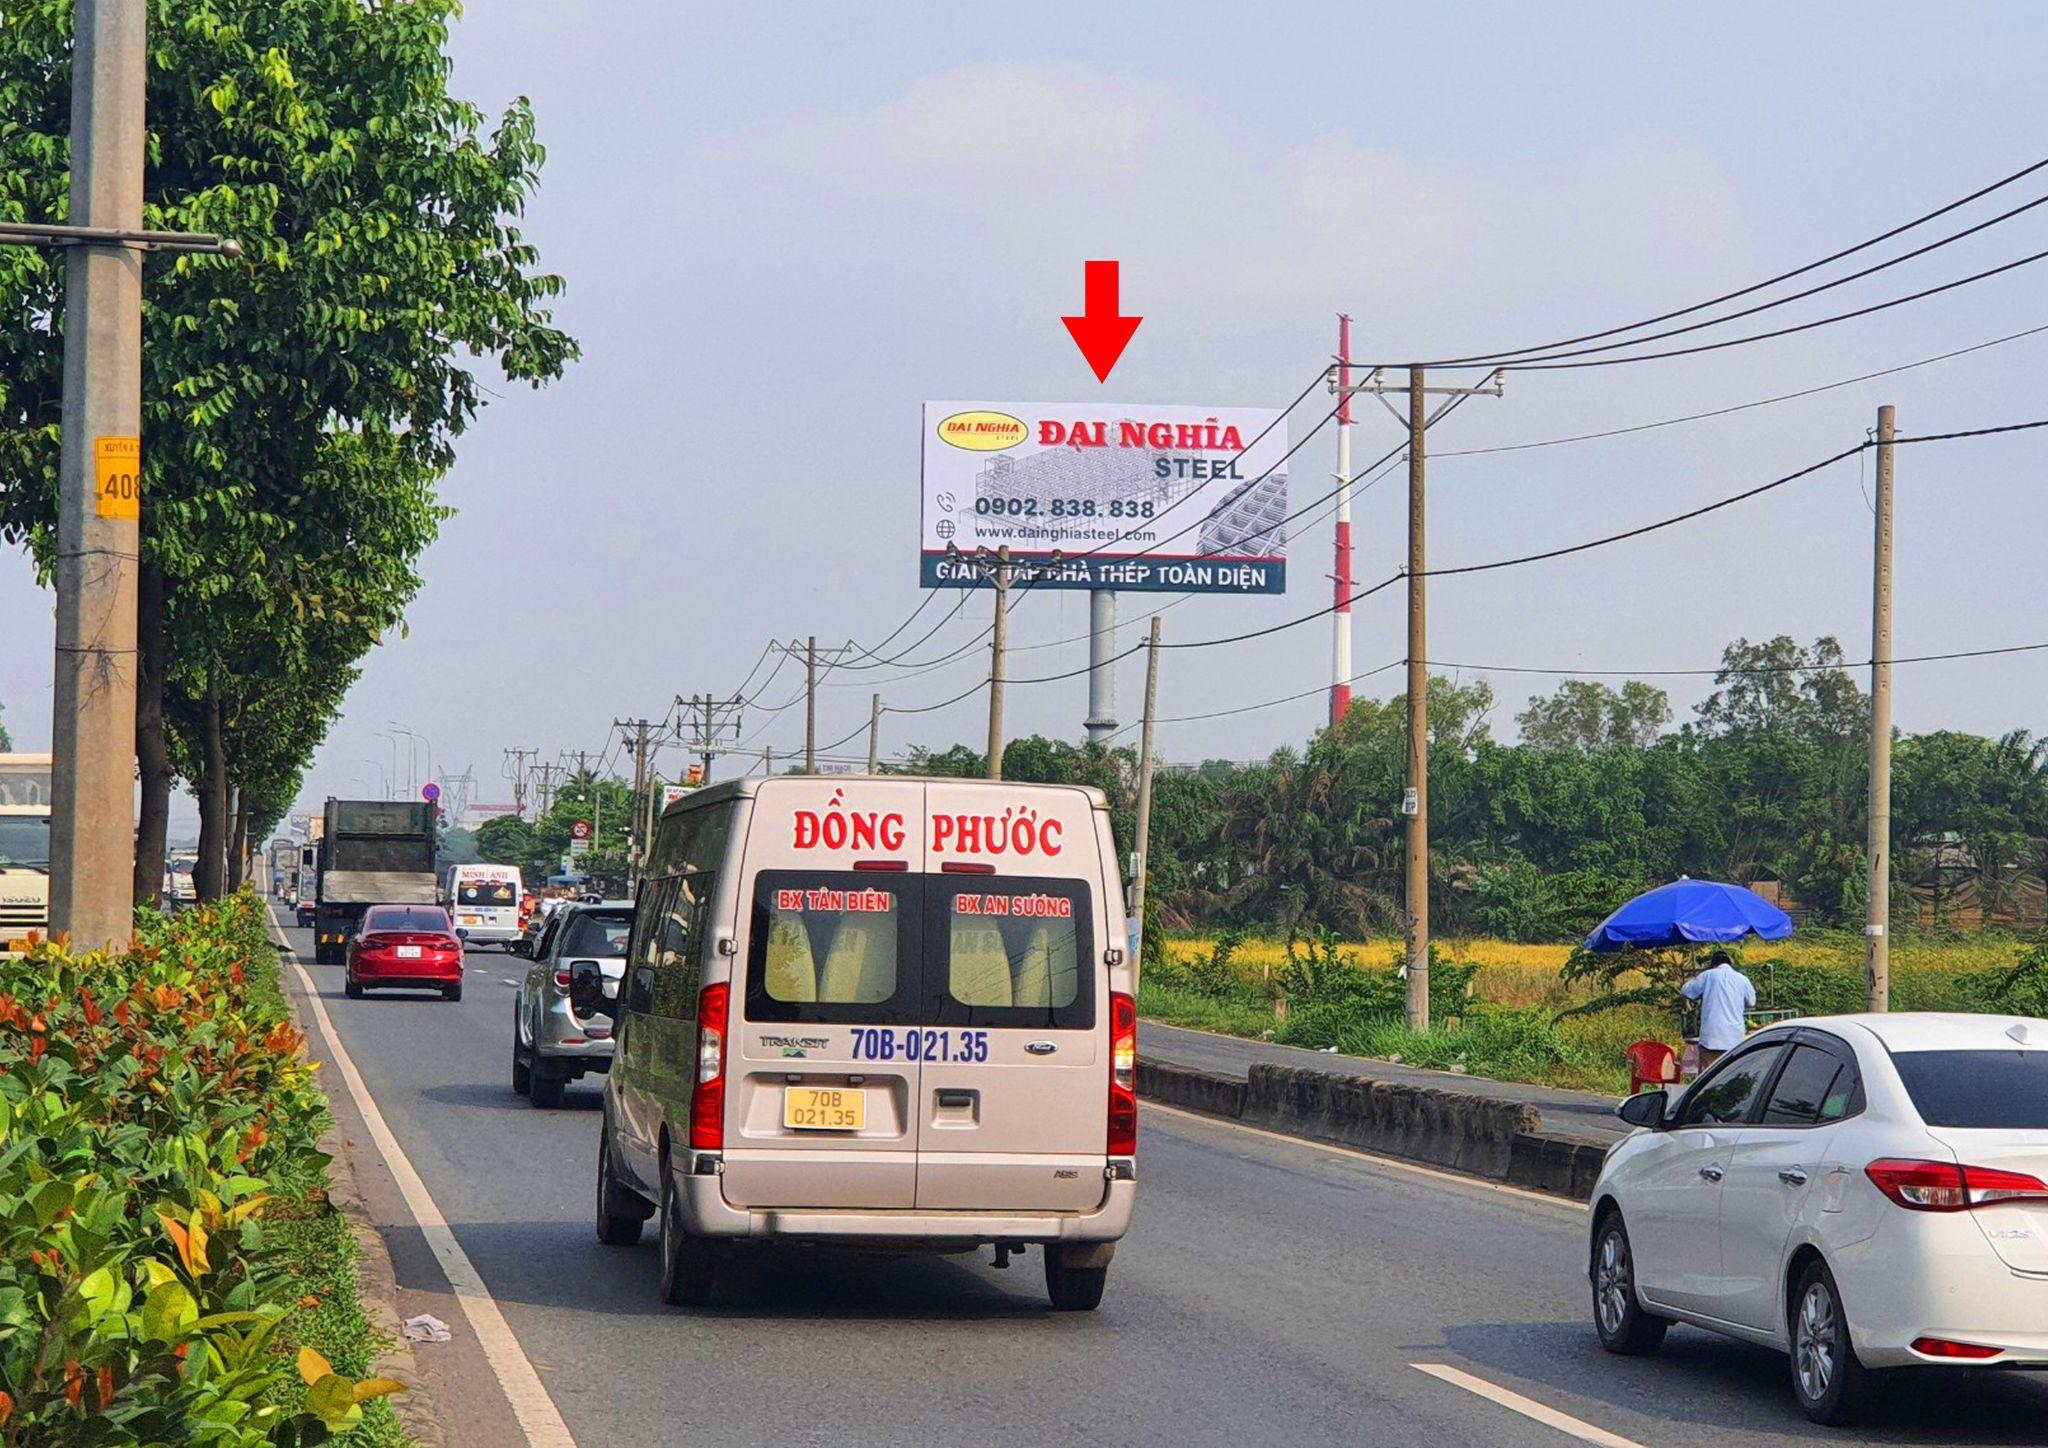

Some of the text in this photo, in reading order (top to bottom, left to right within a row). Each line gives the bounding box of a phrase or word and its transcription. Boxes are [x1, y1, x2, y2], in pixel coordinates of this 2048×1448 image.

[1039, 417, 1244, 453] ĐẠI NGHĨA
[1155, 457, 1244, 480] STEEL
[975, 497, 1155, 519] 0902. 838. 838
[975, 526, 1156, 542] www.dainghiasteel.com
[1099, 561, 1150, 583] THÉP
[1157, 563, 1213, 585] TOÀN
[1218, 565, 1266, 590] DIỆN
[793, 787, 1063, 856] ĐỒNG PHƯỚC
[778, 886, 889, 912] BX TÂN BIÊN
[957, 894, 981, 914] BX
[984, 894, 1009, 915] AN
[760, 1036, 829, 1048] TRANSIT
[850, 1028, 988, 1062] 70B-021.35
[809, 1090, 842, 1107] 70B
[794, 1108, 855, 1126] 021.35
